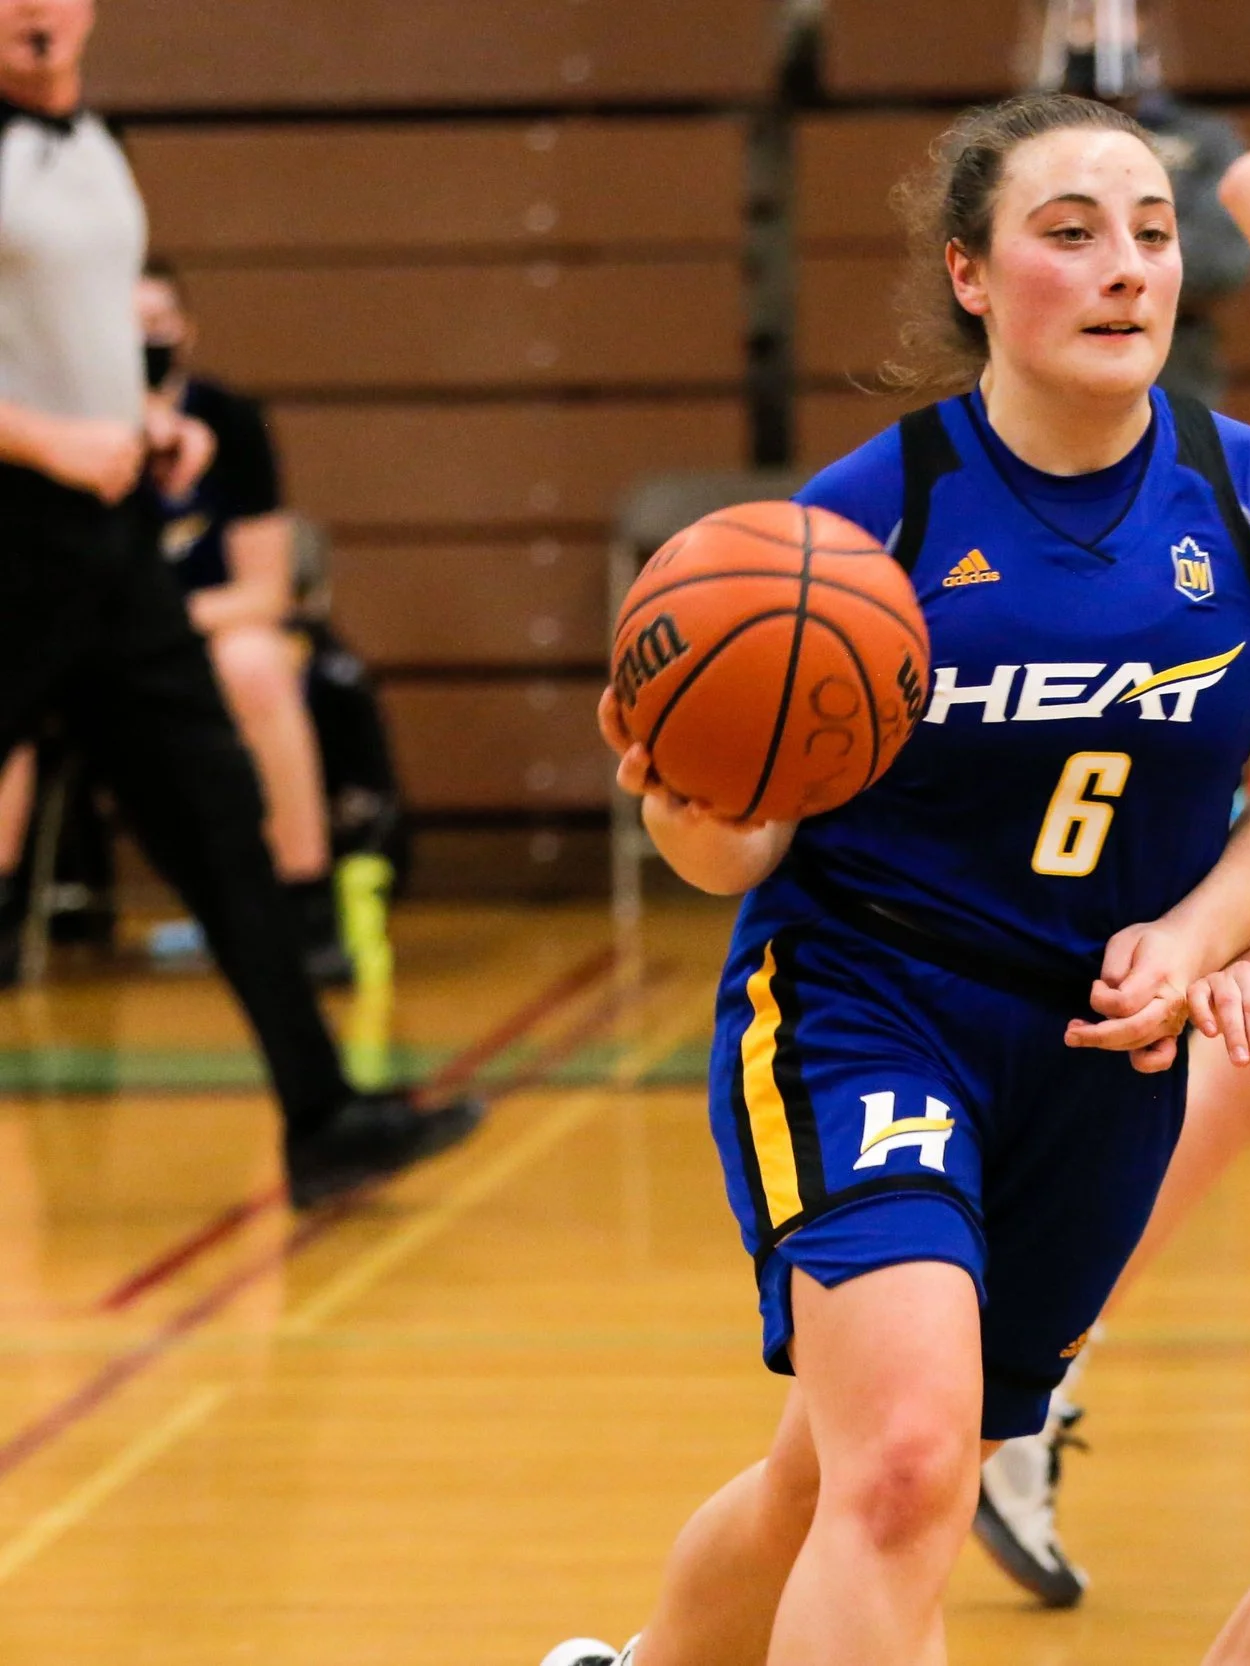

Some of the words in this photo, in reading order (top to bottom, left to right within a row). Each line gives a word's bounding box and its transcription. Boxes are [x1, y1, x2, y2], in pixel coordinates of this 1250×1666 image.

[942, 571, 1000, 587] adidas
[923, 642, 1246, 724] HEAT
[1031, 751, 1132, 877] 6
[852, 1090, 956, 1173] H
